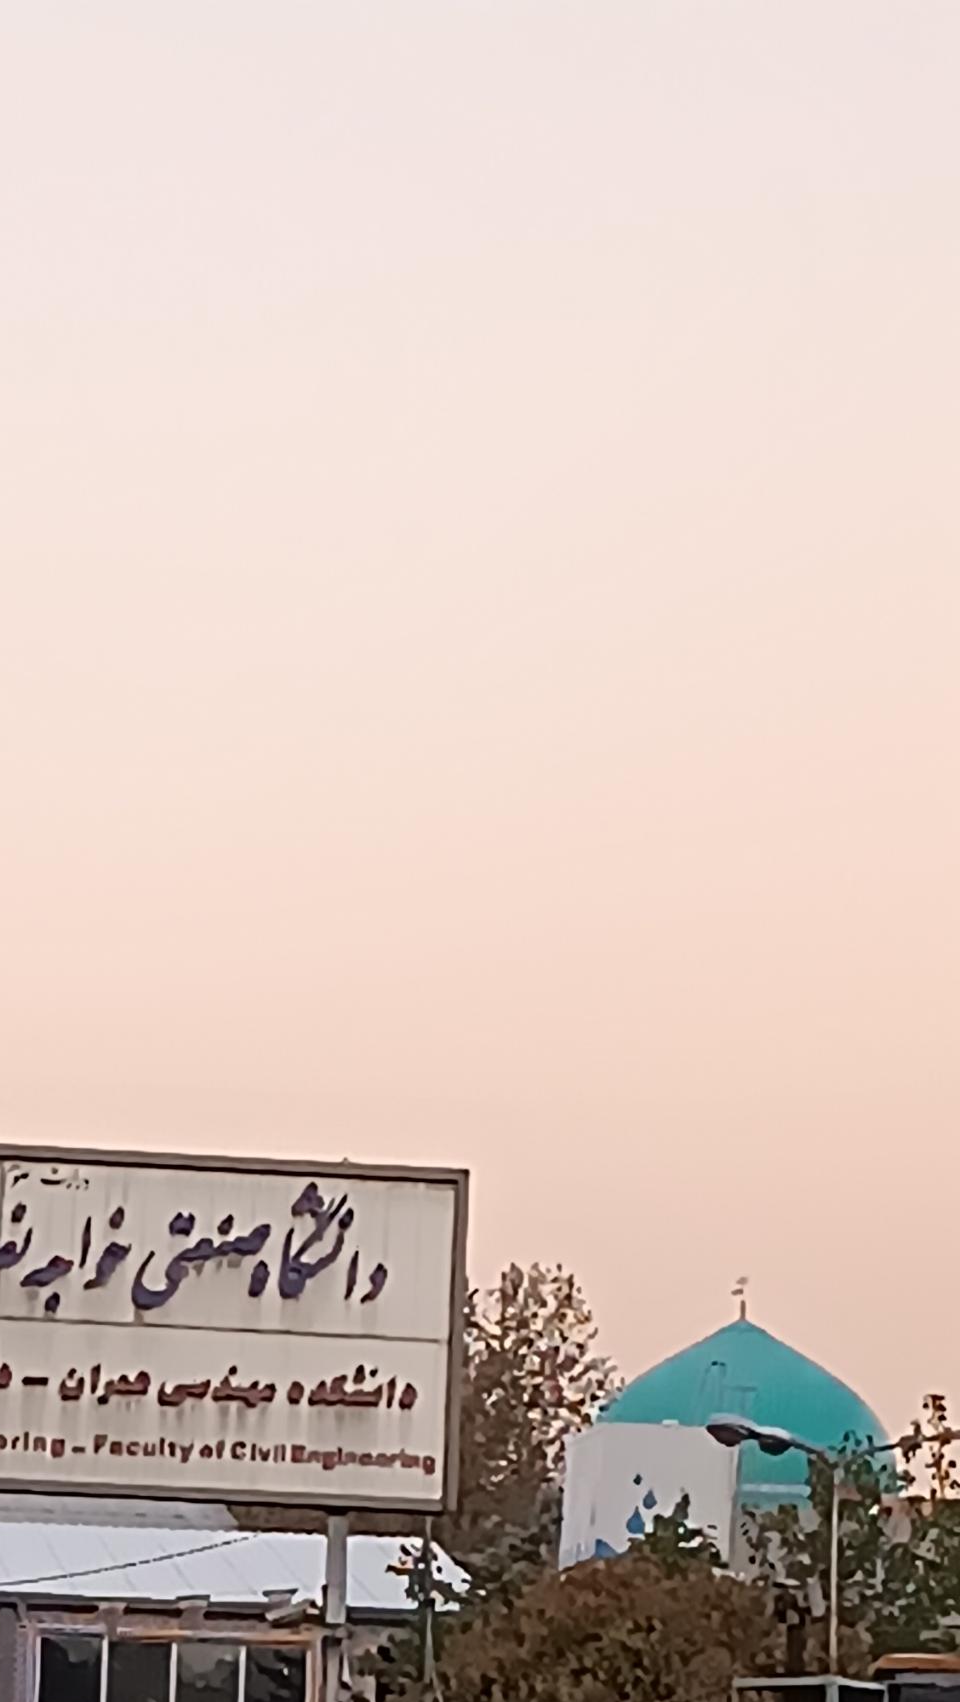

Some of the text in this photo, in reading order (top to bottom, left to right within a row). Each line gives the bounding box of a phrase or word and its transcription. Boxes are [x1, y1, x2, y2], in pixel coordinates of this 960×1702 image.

[20, 1205, 132, 1314] خواجه
[131, 1211, 272, 1311] صنعتی
[247, 1181, 389, 1303] دانشگاه
[58, 1362, 151, 1406] عمران
[157, 1364, 277, 1408] مهندسی
[286, 1362, 419, 1411] دانشکده
[93, 1433, 194, 1464] Faculty
[199, 1438, 226, 1460] of
[229, 1440, 287, 1463] Civil
[289, 1444, 437, 1476] Engineering
